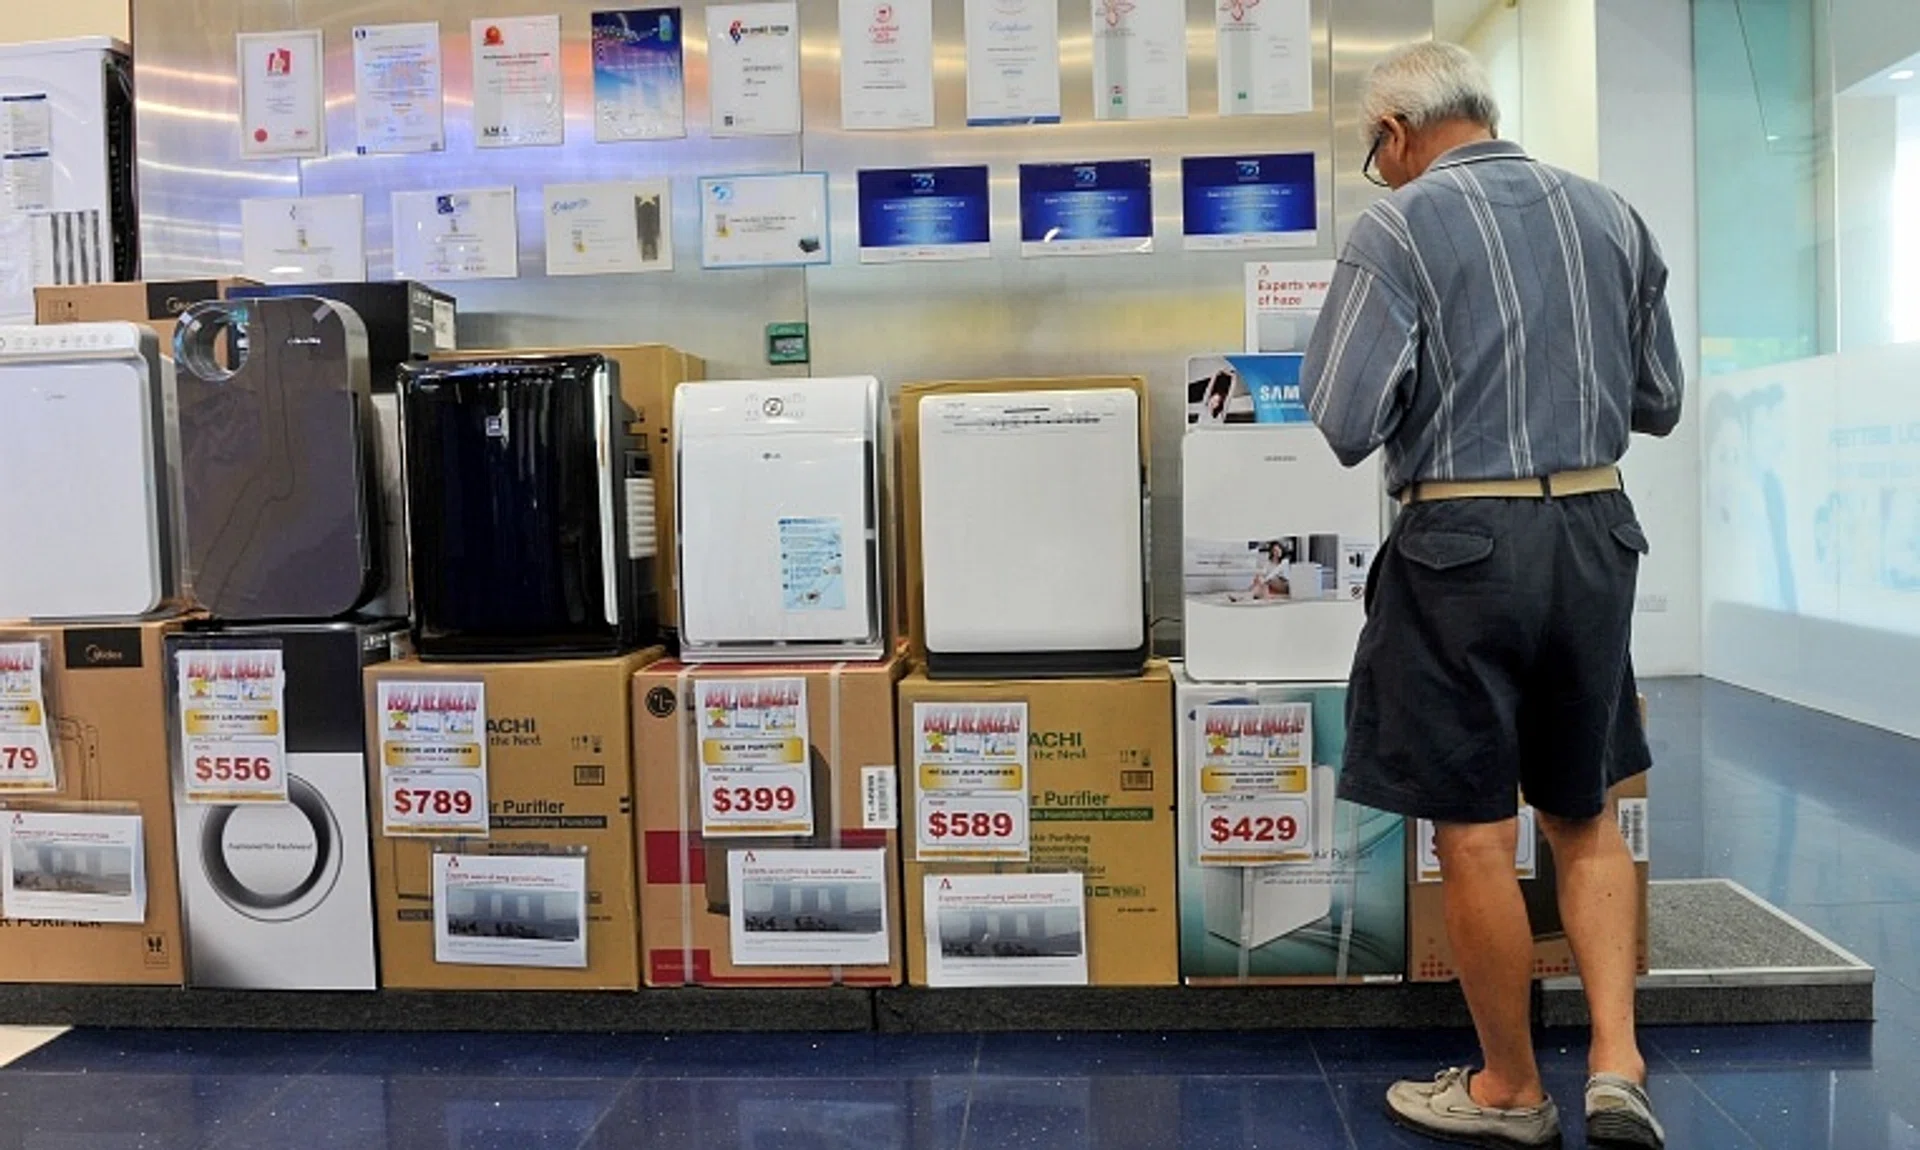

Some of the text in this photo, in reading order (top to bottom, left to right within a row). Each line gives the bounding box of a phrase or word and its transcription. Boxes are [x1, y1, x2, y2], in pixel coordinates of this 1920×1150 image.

[1257, 279, 1329, 292] Experts war
[1257, 295, 1302, 305] of haze
[1260, 385, 1300, 401] SAM
[485, 718, 536, 734] ACHI
[490, 736, 542, 746] the Next
[1029, 732, 1082, 748] ACHI
[0, 747, 38, 769] 79
[1034, 749, 1053, 760] the
[195, 756, 271, 782] $556
[394, 787, 472, 815] $789
[712, 785, 796, 813] $399
[1044, 790, 1110, 806] Purifier
[503, 800, 565, 814] Purifier
[928, 810, 1014, 839] $589
[1210, 815, 1297, 844] $429
